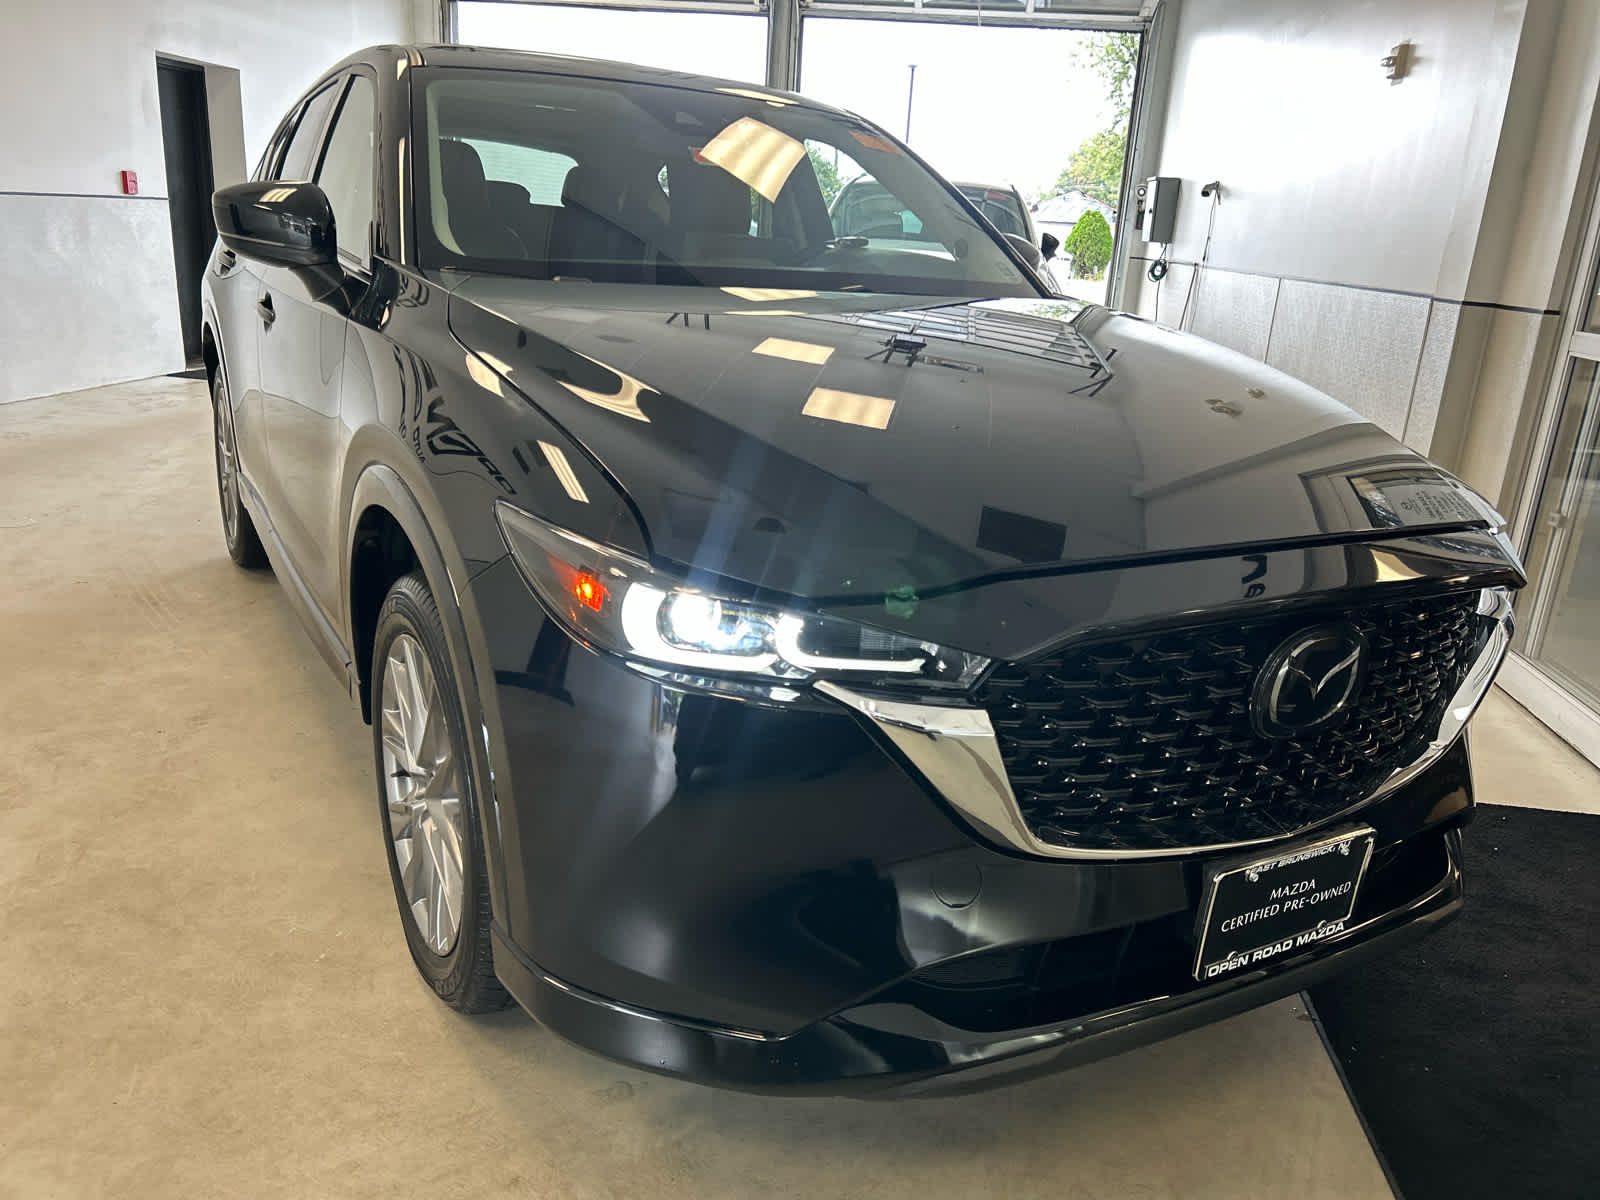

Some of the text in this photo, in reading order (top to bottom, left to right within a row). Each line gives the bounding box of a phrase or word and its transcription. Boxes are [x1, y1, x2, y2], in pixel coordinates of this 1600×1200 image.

[1221, 881, 1352, 933] CERTIFIED PRE-OWNED
[1269, 879, 1317, 900] MAZDA
[1207, 922, 1345, 978] OPEN ROAD MAZDA
